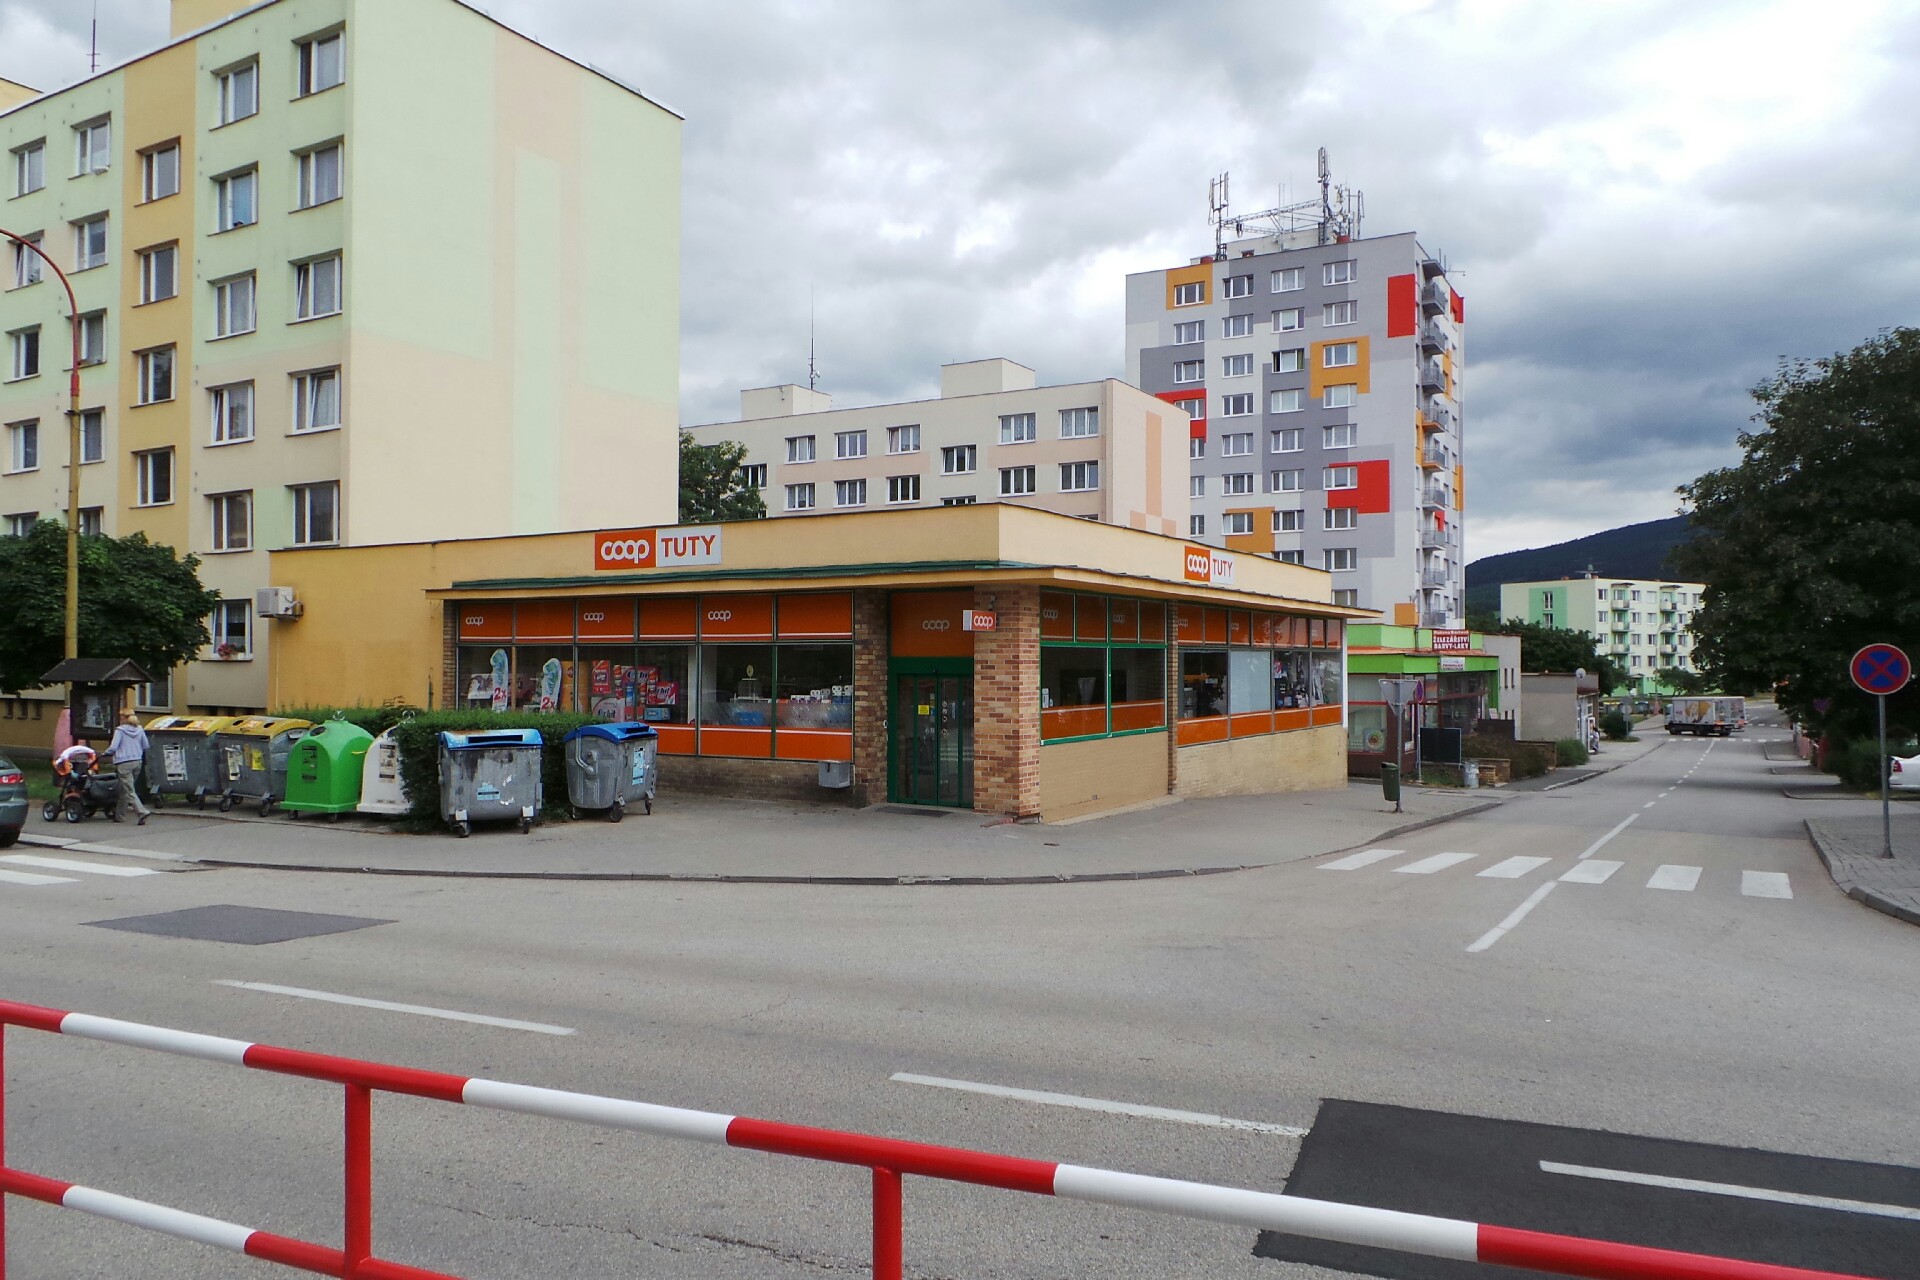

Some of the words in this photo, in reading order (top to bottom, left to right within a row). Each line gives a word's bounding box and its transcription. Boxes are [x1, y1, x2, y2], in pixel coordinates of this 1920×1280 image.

[601, 539, 650, 564] coop
[661, 535, 716, 557] TUTY
[1187, 554, 1209, 578] coop
[1212, 558, 1233, 577] TUTY
[465, 616, 484, 626] coop
[583, 612, 604, 623] coop
[708, 610, 731, 622] coop
[973, 615, 994, 629] coop
[923, 620, 950, 632] coop
[1433, 635, 1470, 643] ŽELEZÁŘSTVÍ
[494, 687, 507, 701] 2x
[541, 697, 556, 710] 2x
